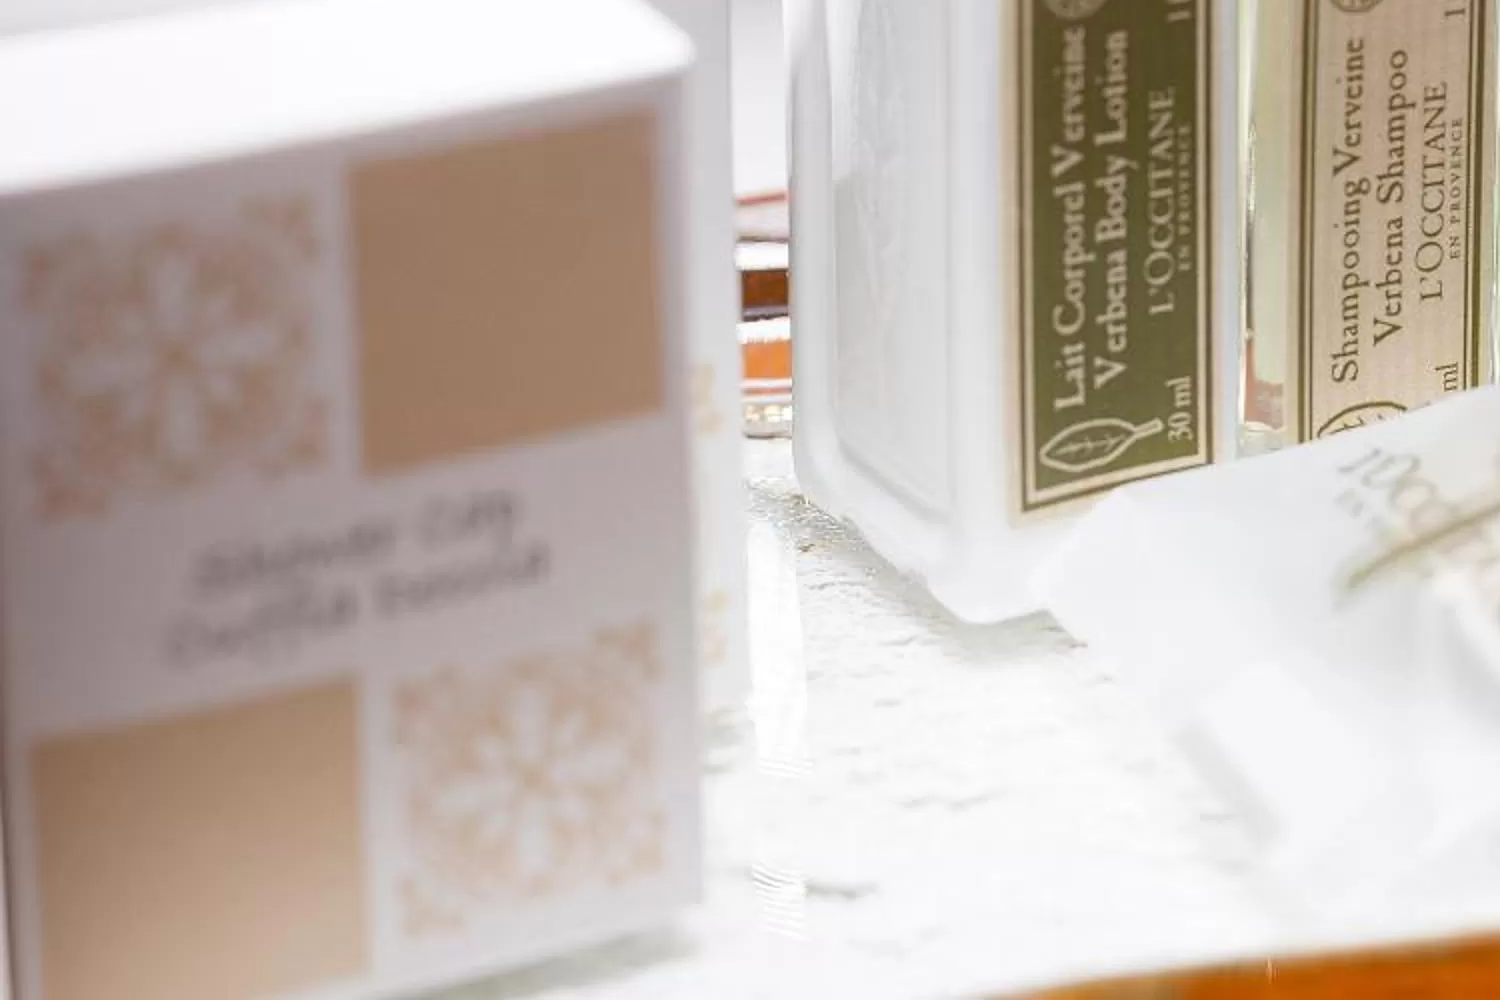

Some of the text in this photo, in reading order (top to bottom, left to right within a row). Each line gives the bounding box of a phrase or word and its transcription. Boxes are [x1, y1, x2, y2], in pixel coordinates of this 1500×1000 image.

[1443, 7, 1466, 18] 1
[1050, 24, 1086, 179] Verveine
[1332, 36, 1365, 177] Verveine
[1052, 181, 1096, 336] Corporel
[1093, 29, 1139, 389] Verbena Body Lotion
[1143, 86, 1176, 315] L'OCCITANE
[1372, 49, 1417, 347] Verbena Shampoo
[1415, 81, 1448, 302] L'OCCITANE
[1449, 117, 1463, 260] EN PROVENCE
[1331, 177, 1371, 383] Shampooing
[1054, 341, 1086, 411] Lait
[1164, 374, 1193, 443] 30 ml
[1435, 361, 1460, 392] ml
